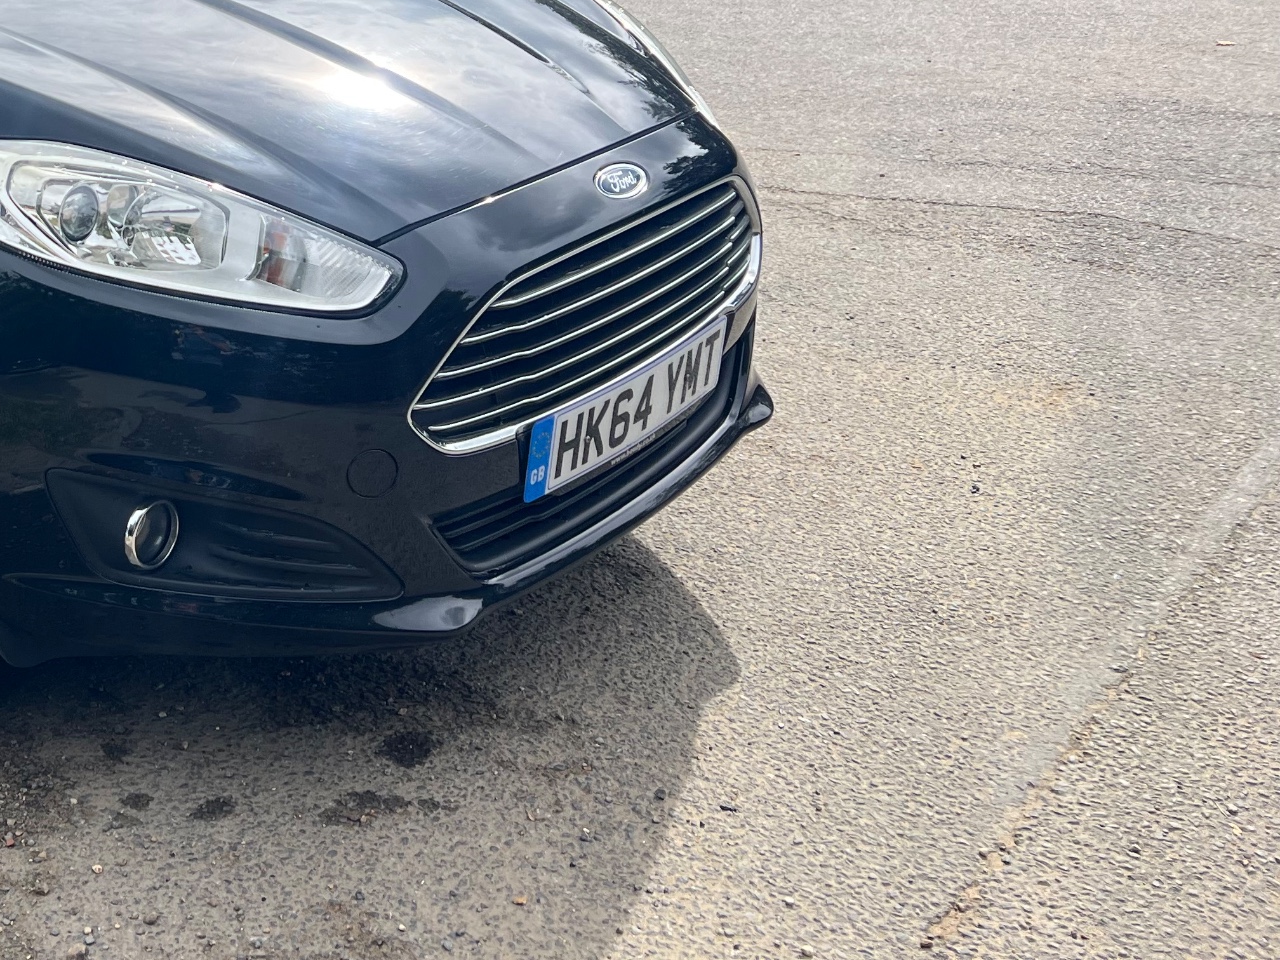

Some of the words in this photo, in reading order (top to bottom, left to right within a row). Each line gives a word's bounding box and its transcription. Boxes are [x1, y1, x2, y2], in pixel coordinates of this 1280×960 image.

[607, 171, 637, 192] Ford
[554, 374, 655, 480] HK64
[667, 328, 721, 415] YMT
[529, 465, 546, 486] GB
